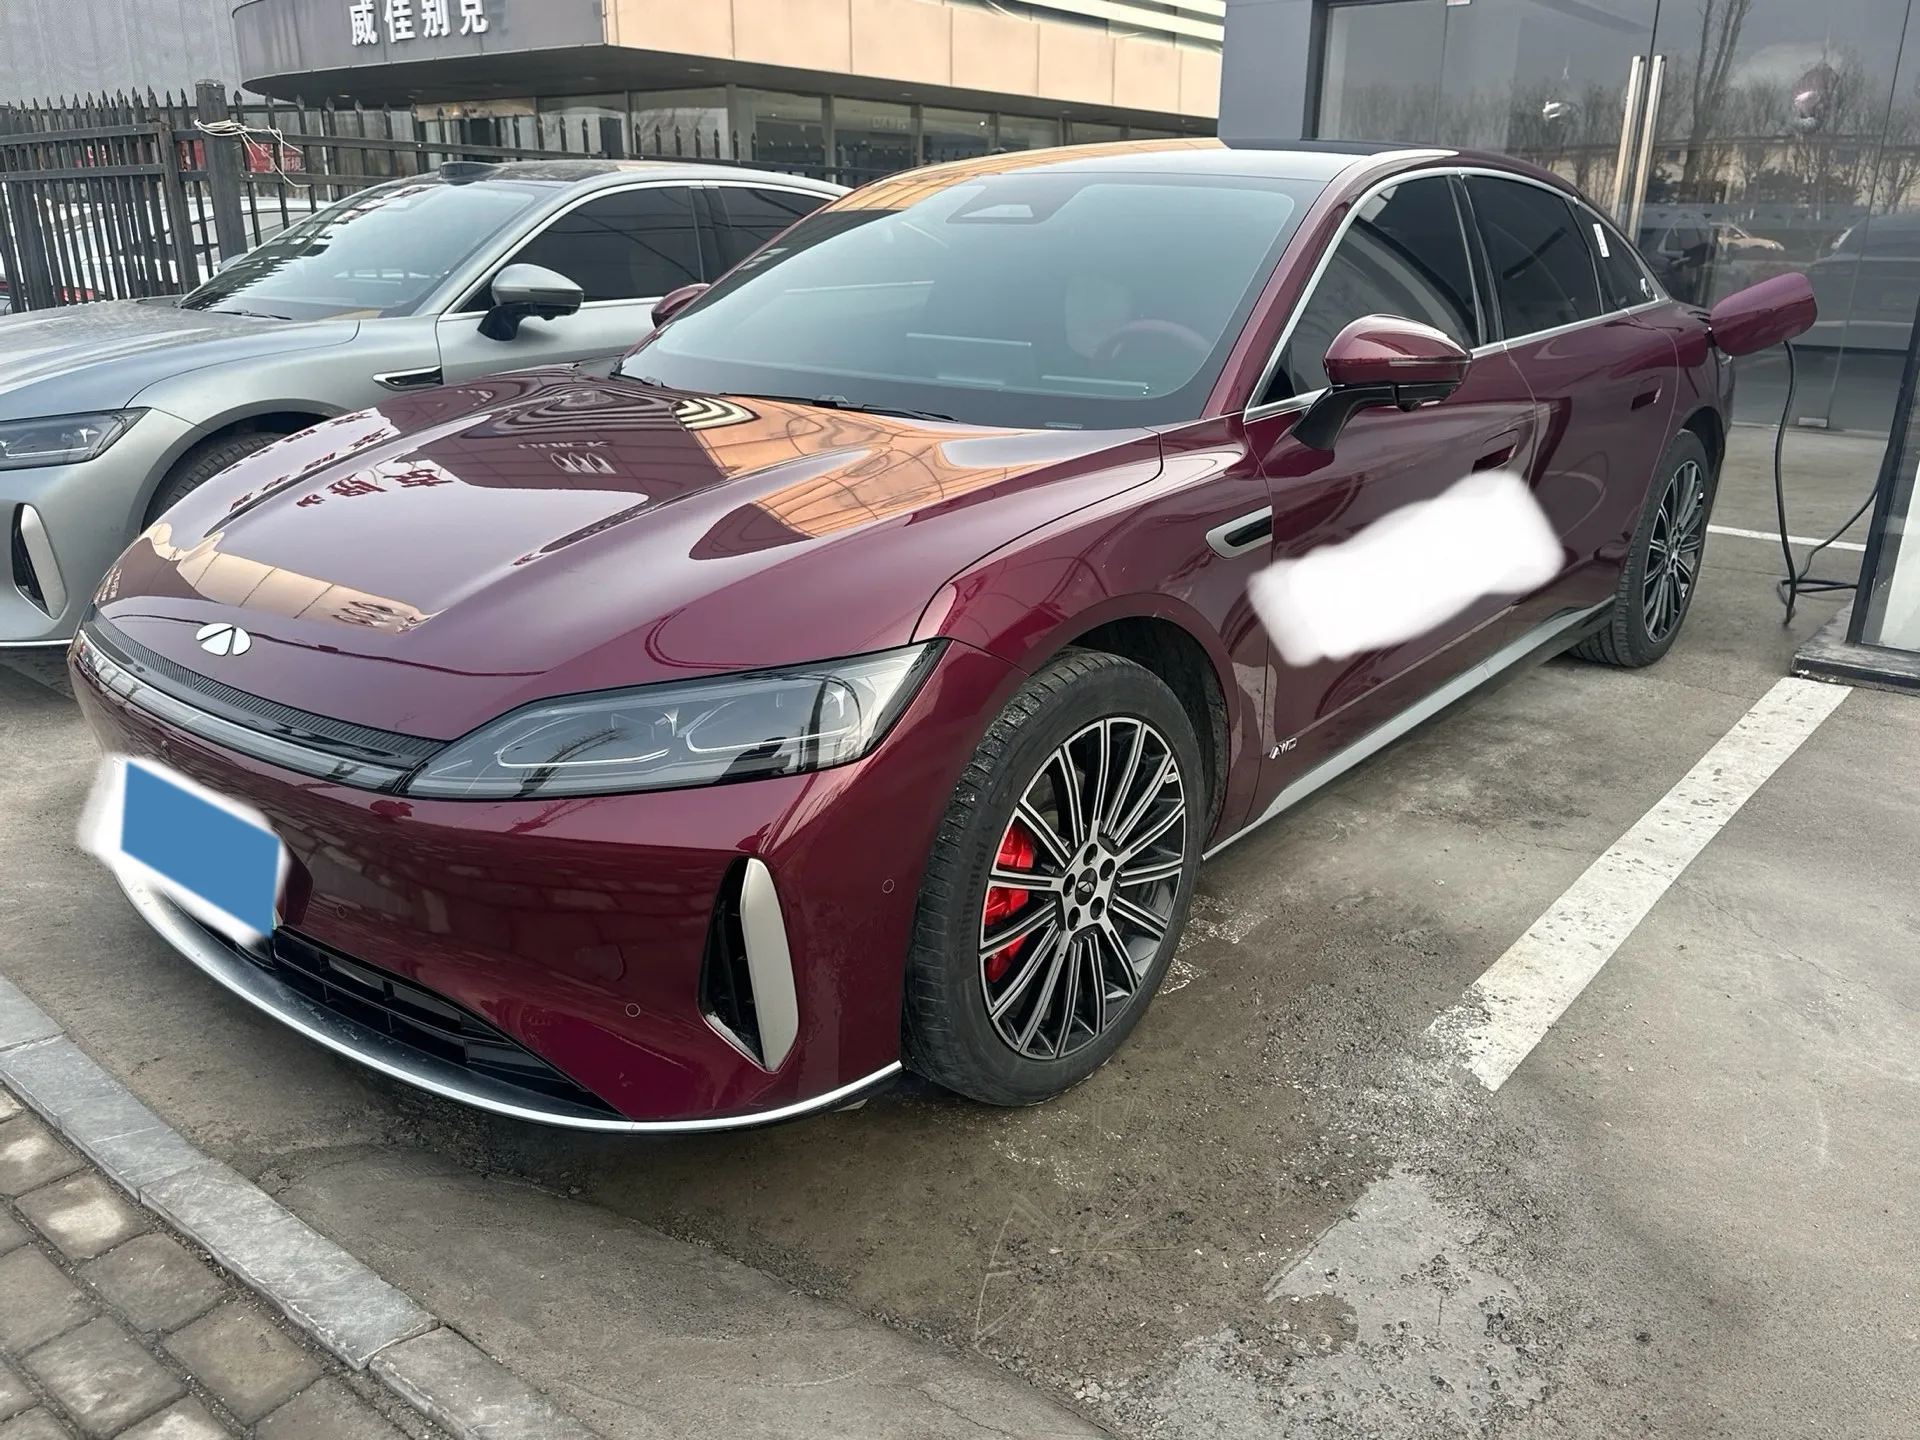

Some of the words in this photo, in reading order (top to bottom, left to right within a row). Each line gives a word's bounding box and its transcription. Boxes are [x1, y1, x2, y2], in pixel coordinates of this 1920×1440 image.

[350, 0, 489, 46] 威佳别克
[1269, 737, 1297, 759] AWD
